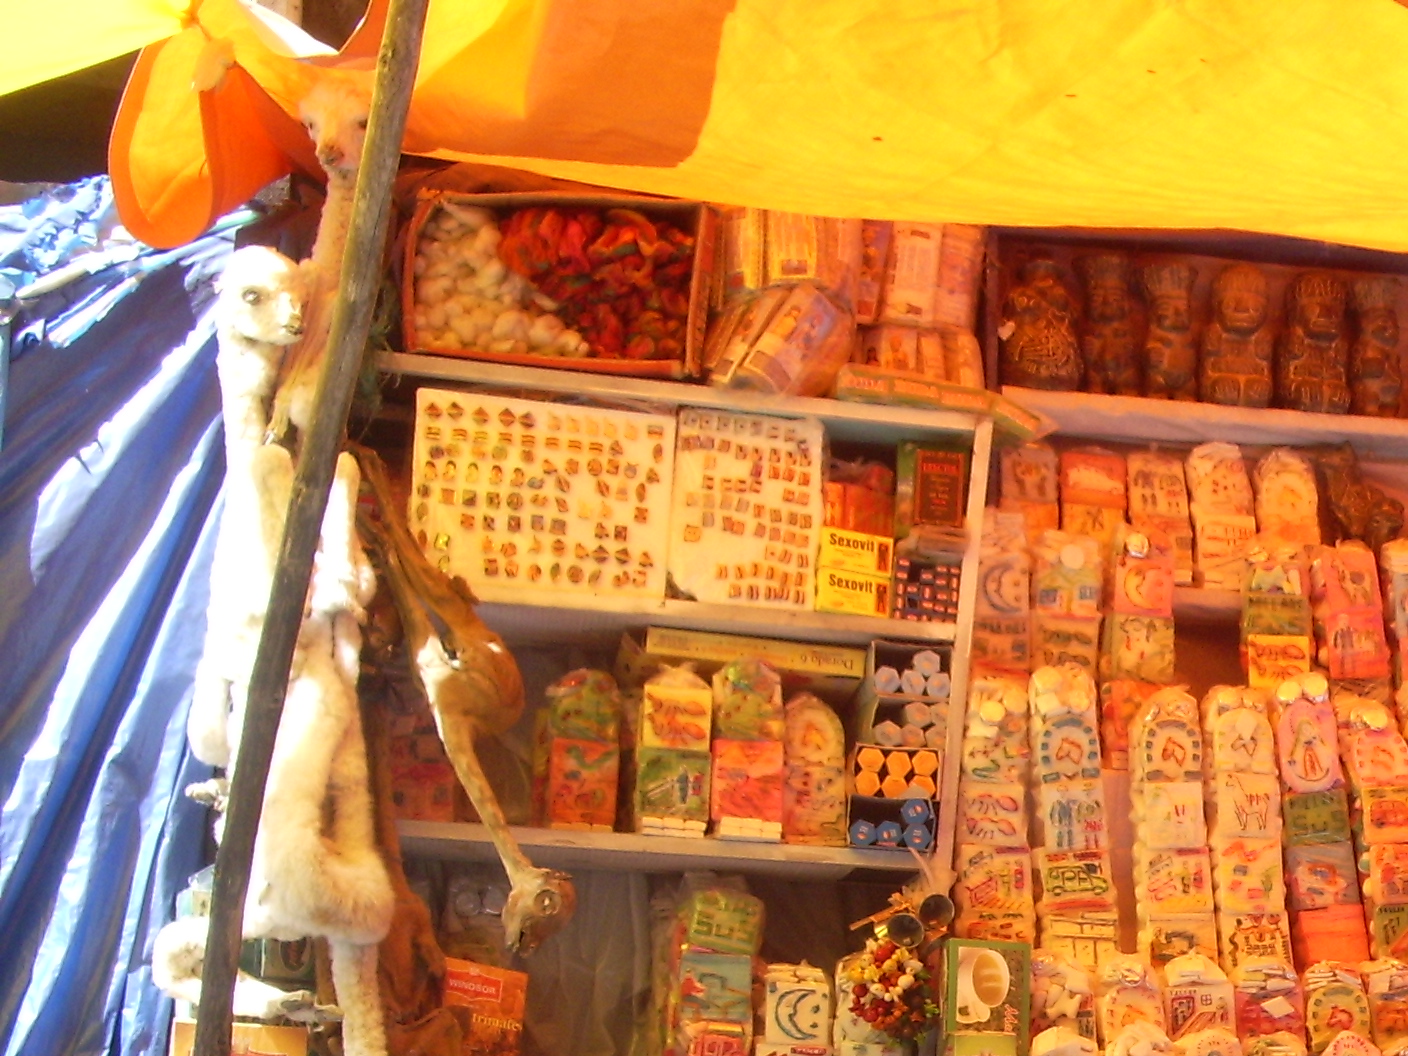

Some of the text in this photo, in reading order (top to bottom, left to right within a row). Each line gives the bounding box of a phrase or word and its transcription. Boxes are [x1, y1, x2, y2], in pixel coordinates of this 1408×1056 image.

[829, 533, 875, 552] Sexovit
[828, 573, 873, 593] Sexovit
[449, 979, 497, 995] WINDSOR
